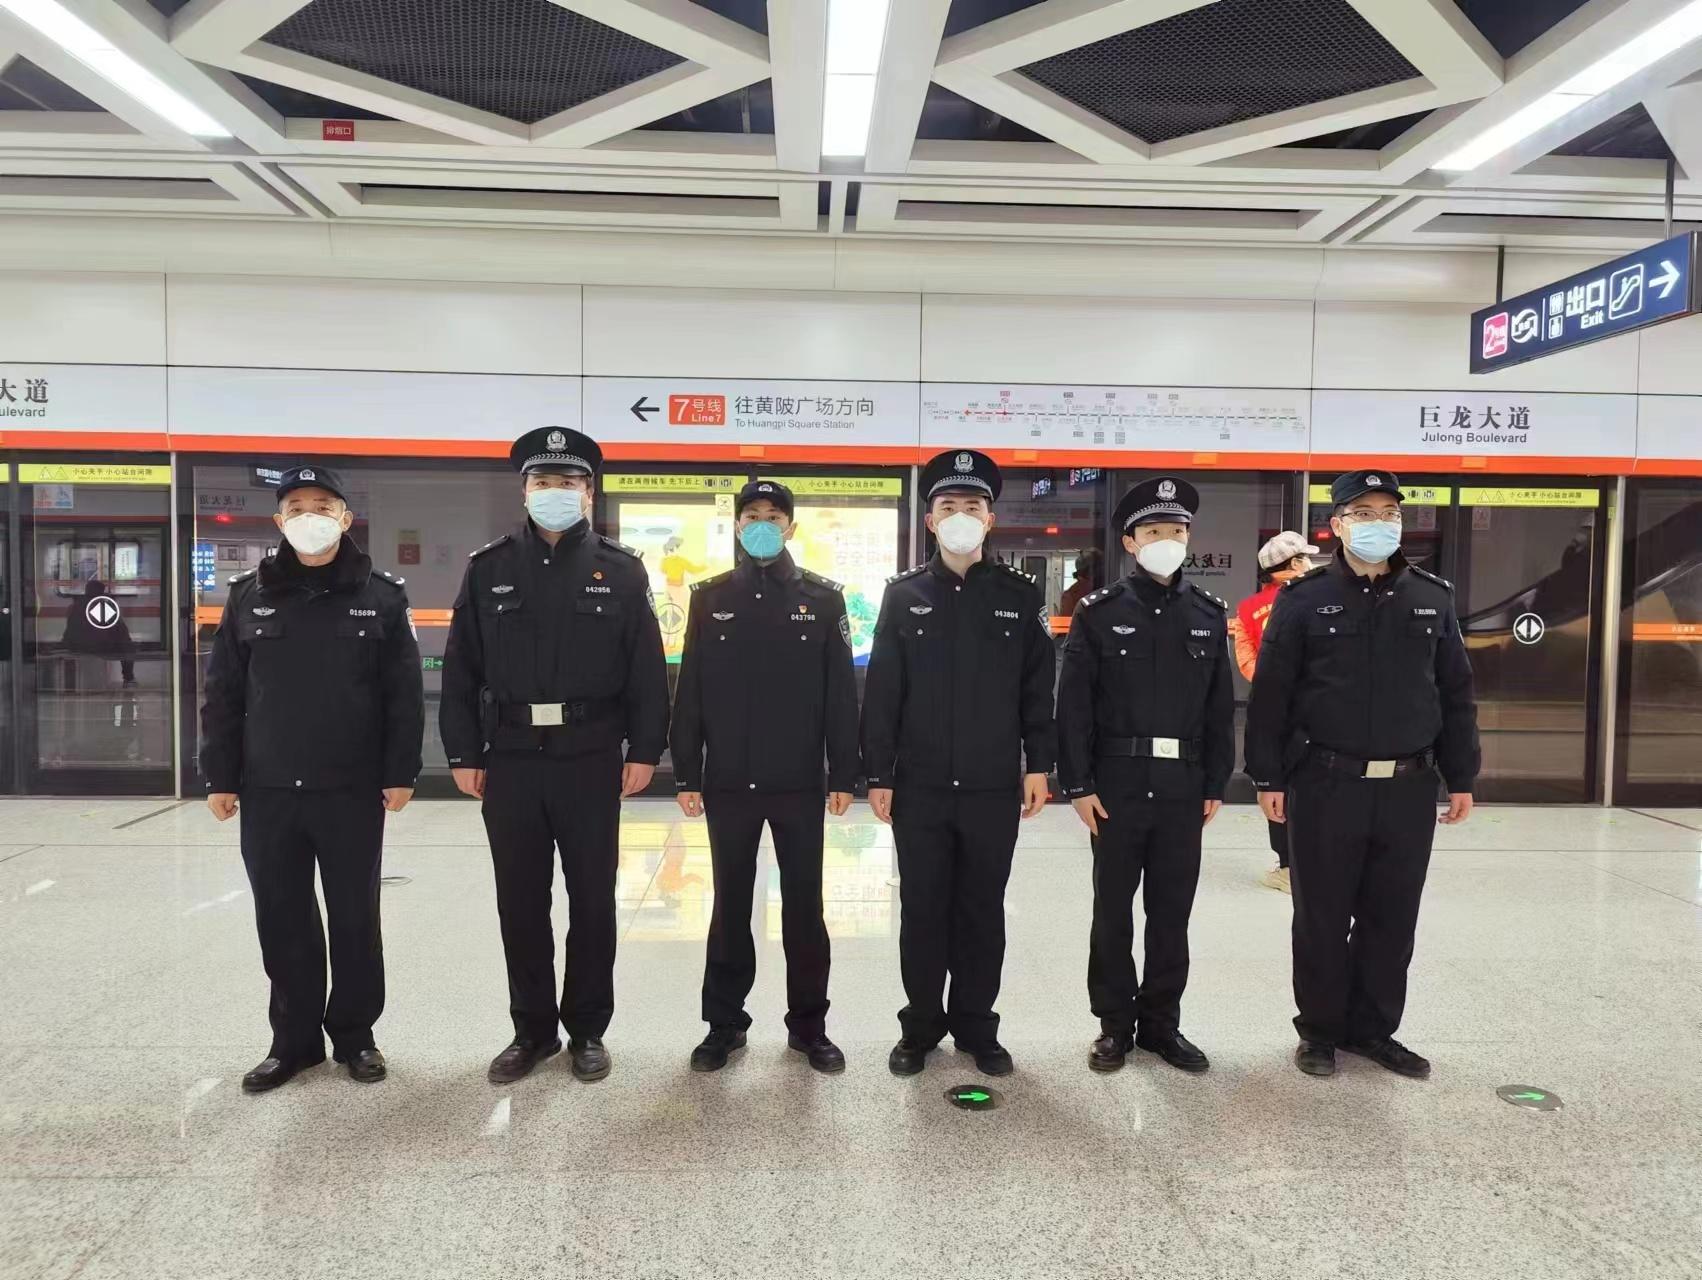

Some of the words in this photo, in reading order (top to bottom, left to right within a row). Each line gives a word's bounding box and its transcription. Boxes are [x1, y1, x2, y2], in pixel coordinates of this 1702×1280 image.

[1566, 278, 1606, 318] 出口
[1580, 310, 1604, 329] Exit
[0, 379, 49, 403] 大道
[674, 398, 690, 422] 7
[691, 398, 722, 413] 号线
[734, 396, 874, 416] 往黄陂广场方向
[734, 418, 746, 428] To
[747, 419, 786, 430] Huangpi
[787, 420, 821, 430] Square
[823, 420, 855, 430] Station
[1420, 405, 1531, 430] 巨龙大道
[1421, 432, 1463, 445] Julong
[1466, 433, 1527, 443] Boulevard
